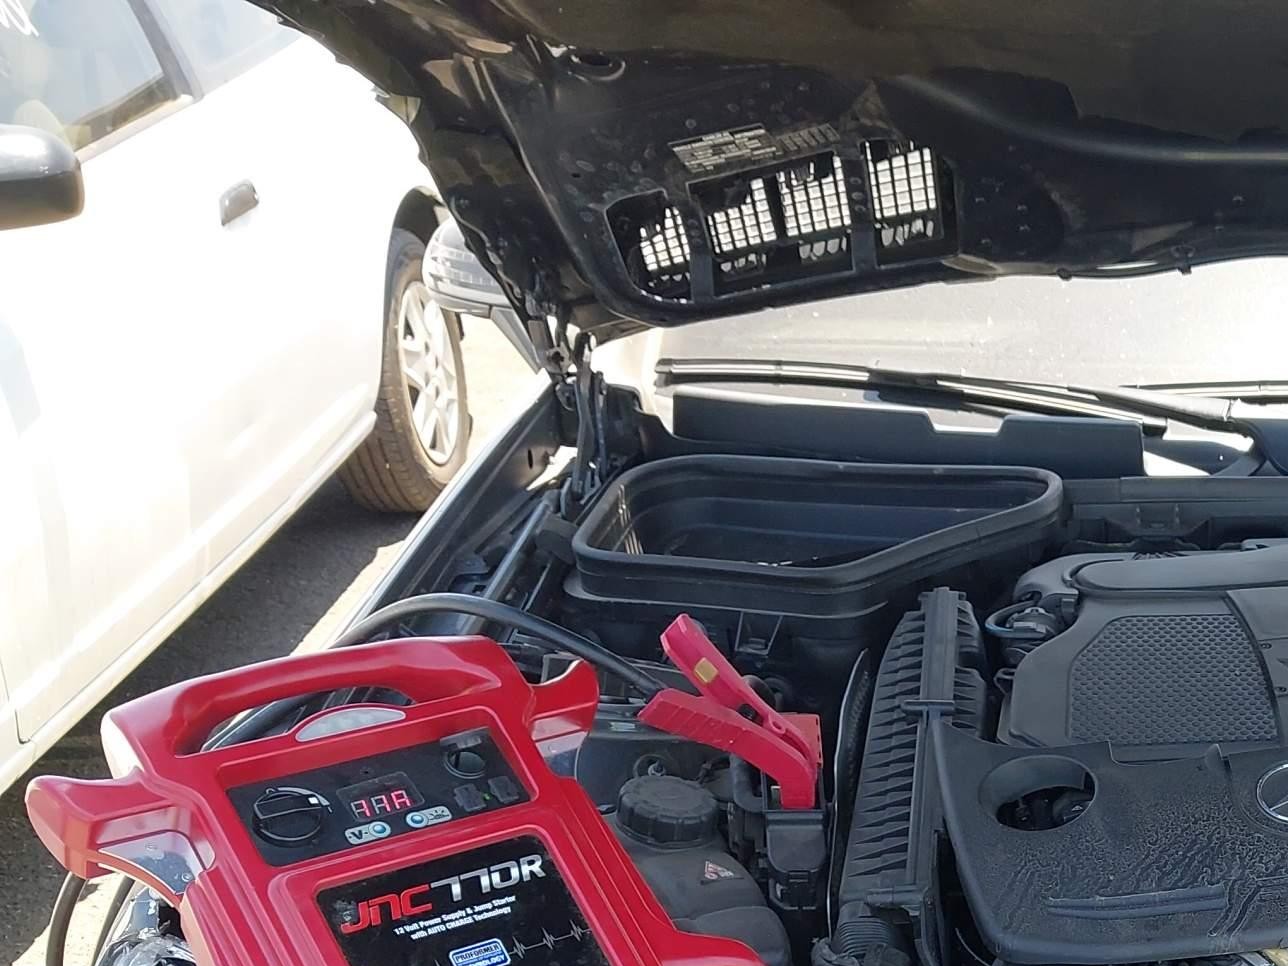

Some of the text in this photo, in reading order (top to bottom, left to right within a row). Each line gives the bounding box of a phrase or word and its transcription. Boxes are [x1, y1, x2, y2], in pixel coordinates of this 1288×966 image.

[420, 917, 442, 929] Power
[443, 911, 466, 923] Supply
[474, 903, 493, 914] Jump
[494, 895, 516, 907] Starter
[427, 924, 446, 935] AUTO
[447, 917, 473, 930] CHARGE
[474, 906, 512, 921] Technology
[455, 944, 499, 962] PROFORMER
